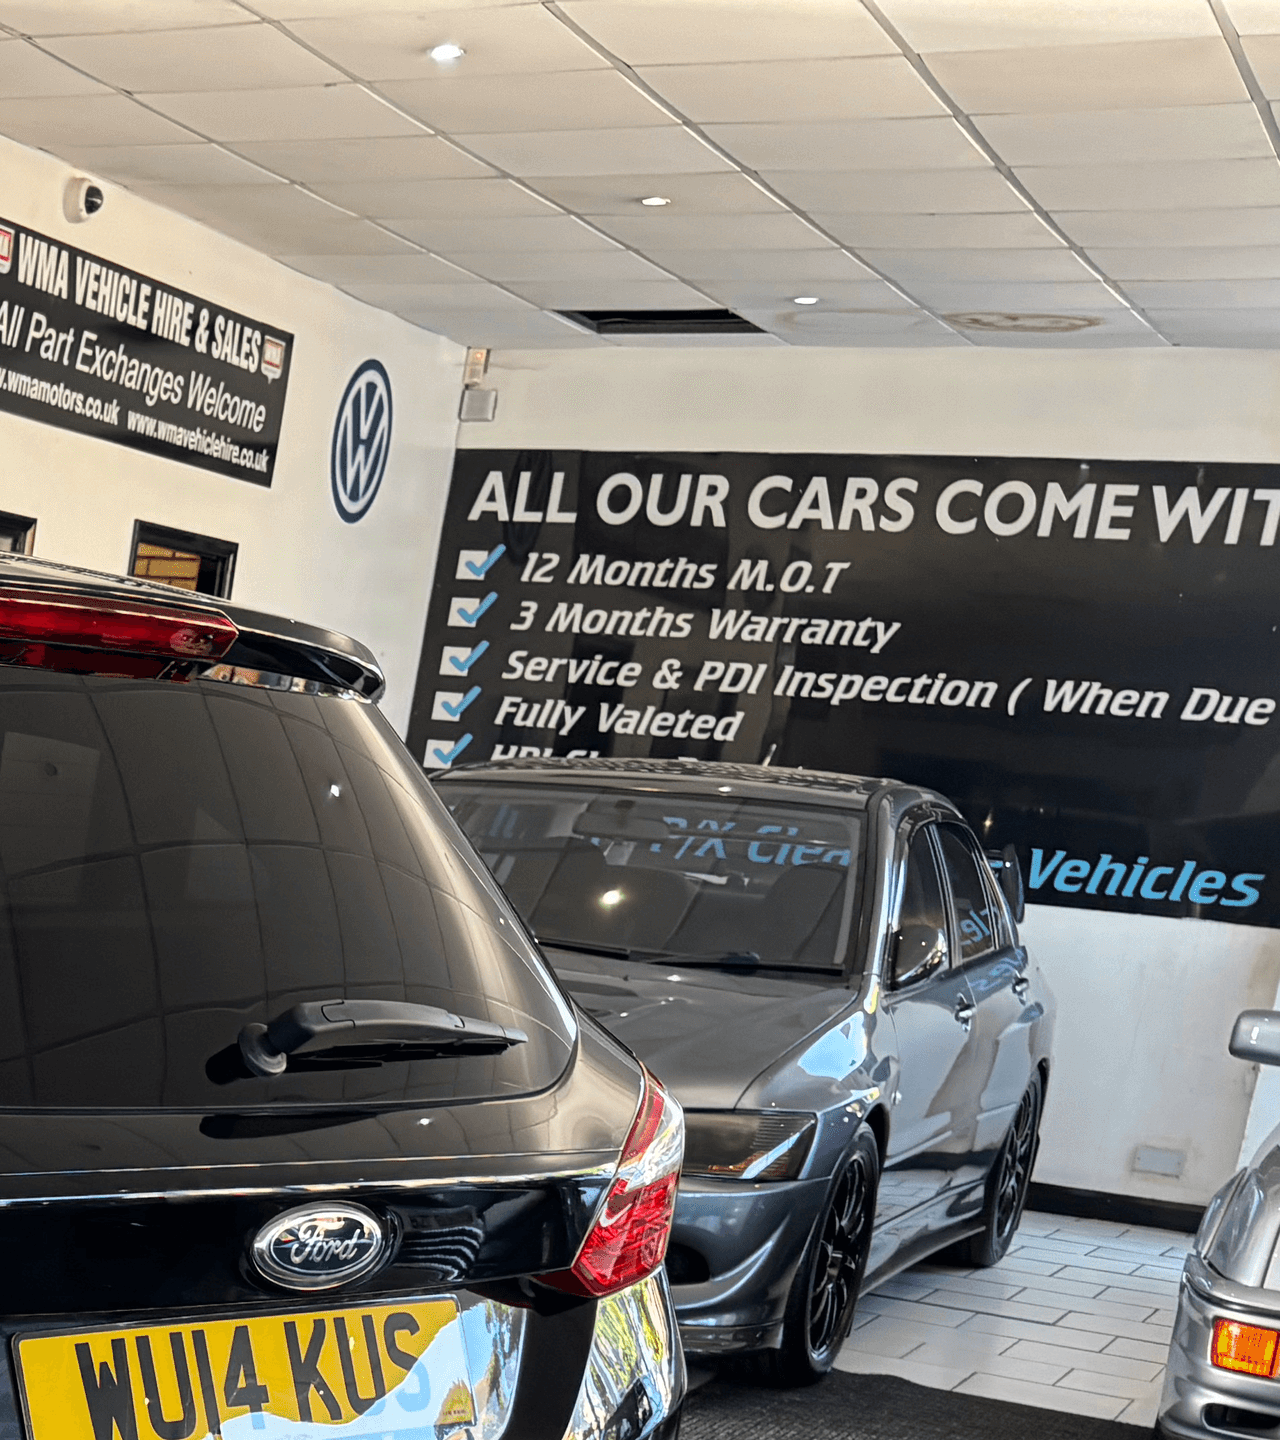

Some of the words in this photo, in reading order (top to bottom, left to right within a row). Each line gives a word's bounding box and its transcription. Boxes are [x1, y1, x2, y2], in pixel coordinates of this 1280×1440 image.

[17, 232, 69, 300] WMA
[75, 255, 152, 331] VEHICLE
[151, 289, 195, 347] HIRE
[195, 308, 210, 354] &
[211, 314, 262, 373] SALES
[24, 312, 75, 366] Part
[75, 330, 185, 407] Exchanges
[187, 371, 266, 433] Welcome
[127, 410, 270, 473] www.wmavehiclehire.co.uk
[467, 470, 577, 523] ALL
[596, 472, 730, 527] OUR
[747, 475, 919, 533] CARS
[936, 479, 1140, 541] COME
[520, 552, 560, 584] 12
[567, 553, 717, 589] Months
[727, 558, 851, 594] M.O.T
[510, 600, 538, 631] 3
[545, 602, 694, 639] Months
[708, 607, 902, 654] Warranty
[494, 696, 586, 736] Fully
[598, 702, 746, 742] Valeted
[501, 650, 642, 687] Service
[652, 658, 684, 691] &
[693, 660, 768, 696] PDI
[774, 665, 999, 708] Inspection
[1042, 678, 1170, 719] When
[1180, 687, 1277, 726] Due
[1028, 848, 1266, 908] Vehicles
[290, 1219, 361, 1264] Ford
[284, 1312, 432, 1424] KUS
